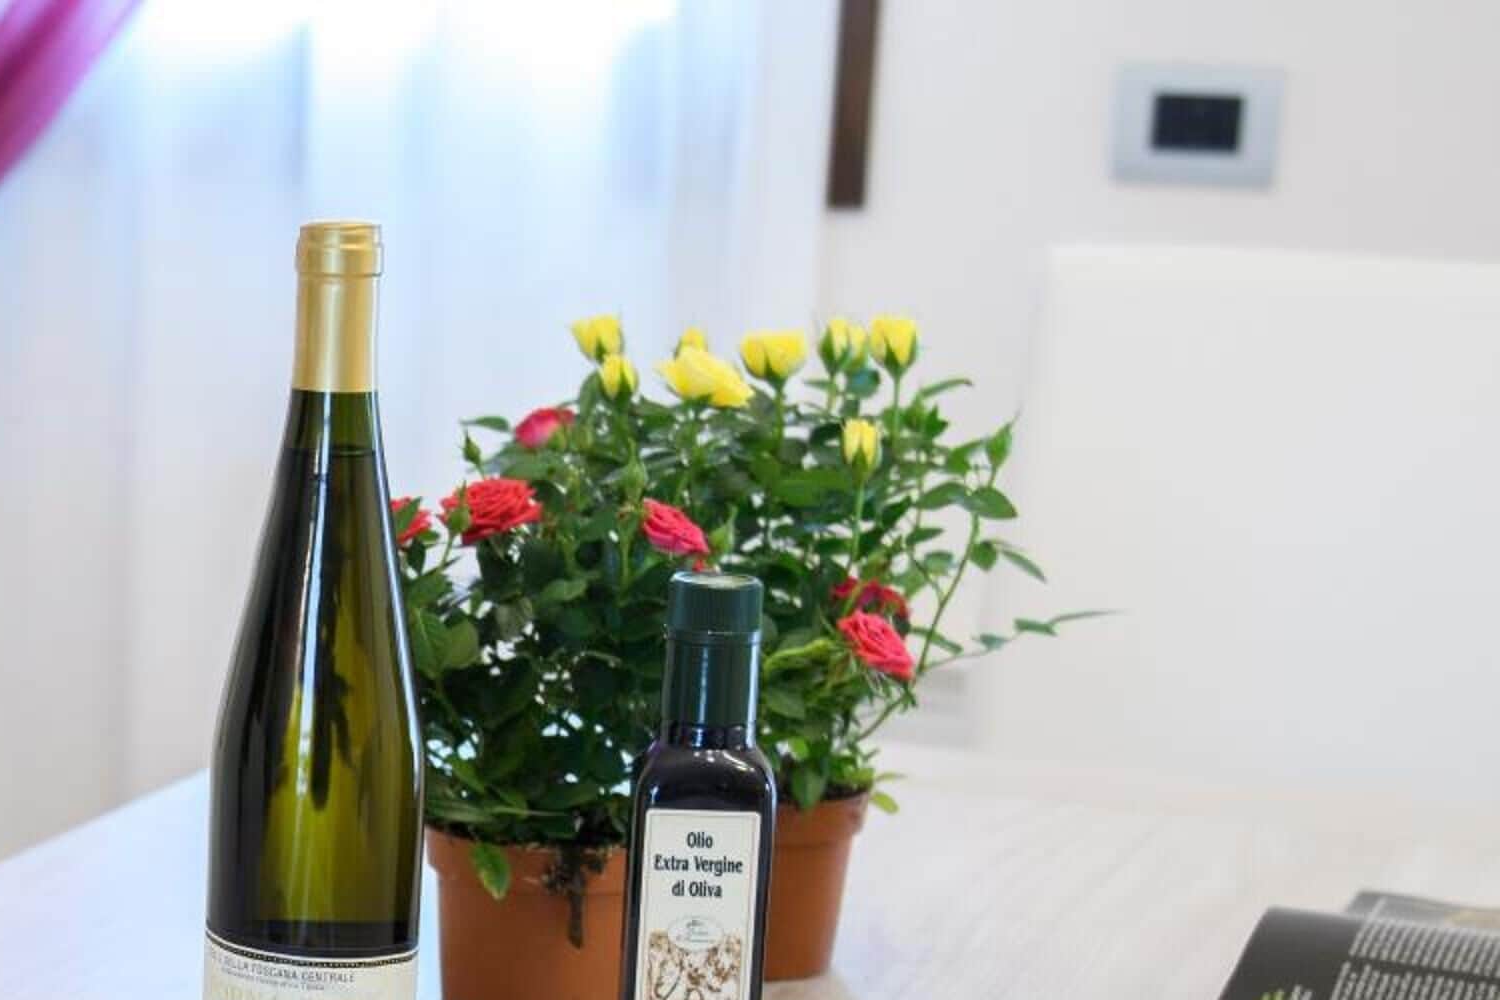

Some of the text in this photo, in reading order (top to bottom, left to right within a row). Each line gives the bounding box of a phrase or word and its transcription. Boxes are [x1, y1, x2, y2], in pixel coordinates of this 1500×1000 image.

[686, 831, 714, 849] Olio
[653, 854, 744, 877] Extra Vergine
[671, 879, 723, 898] di Oliva
[252, 963, 297, 980] TOSCANA
[302, 970, 356, 983] CENTRALE
